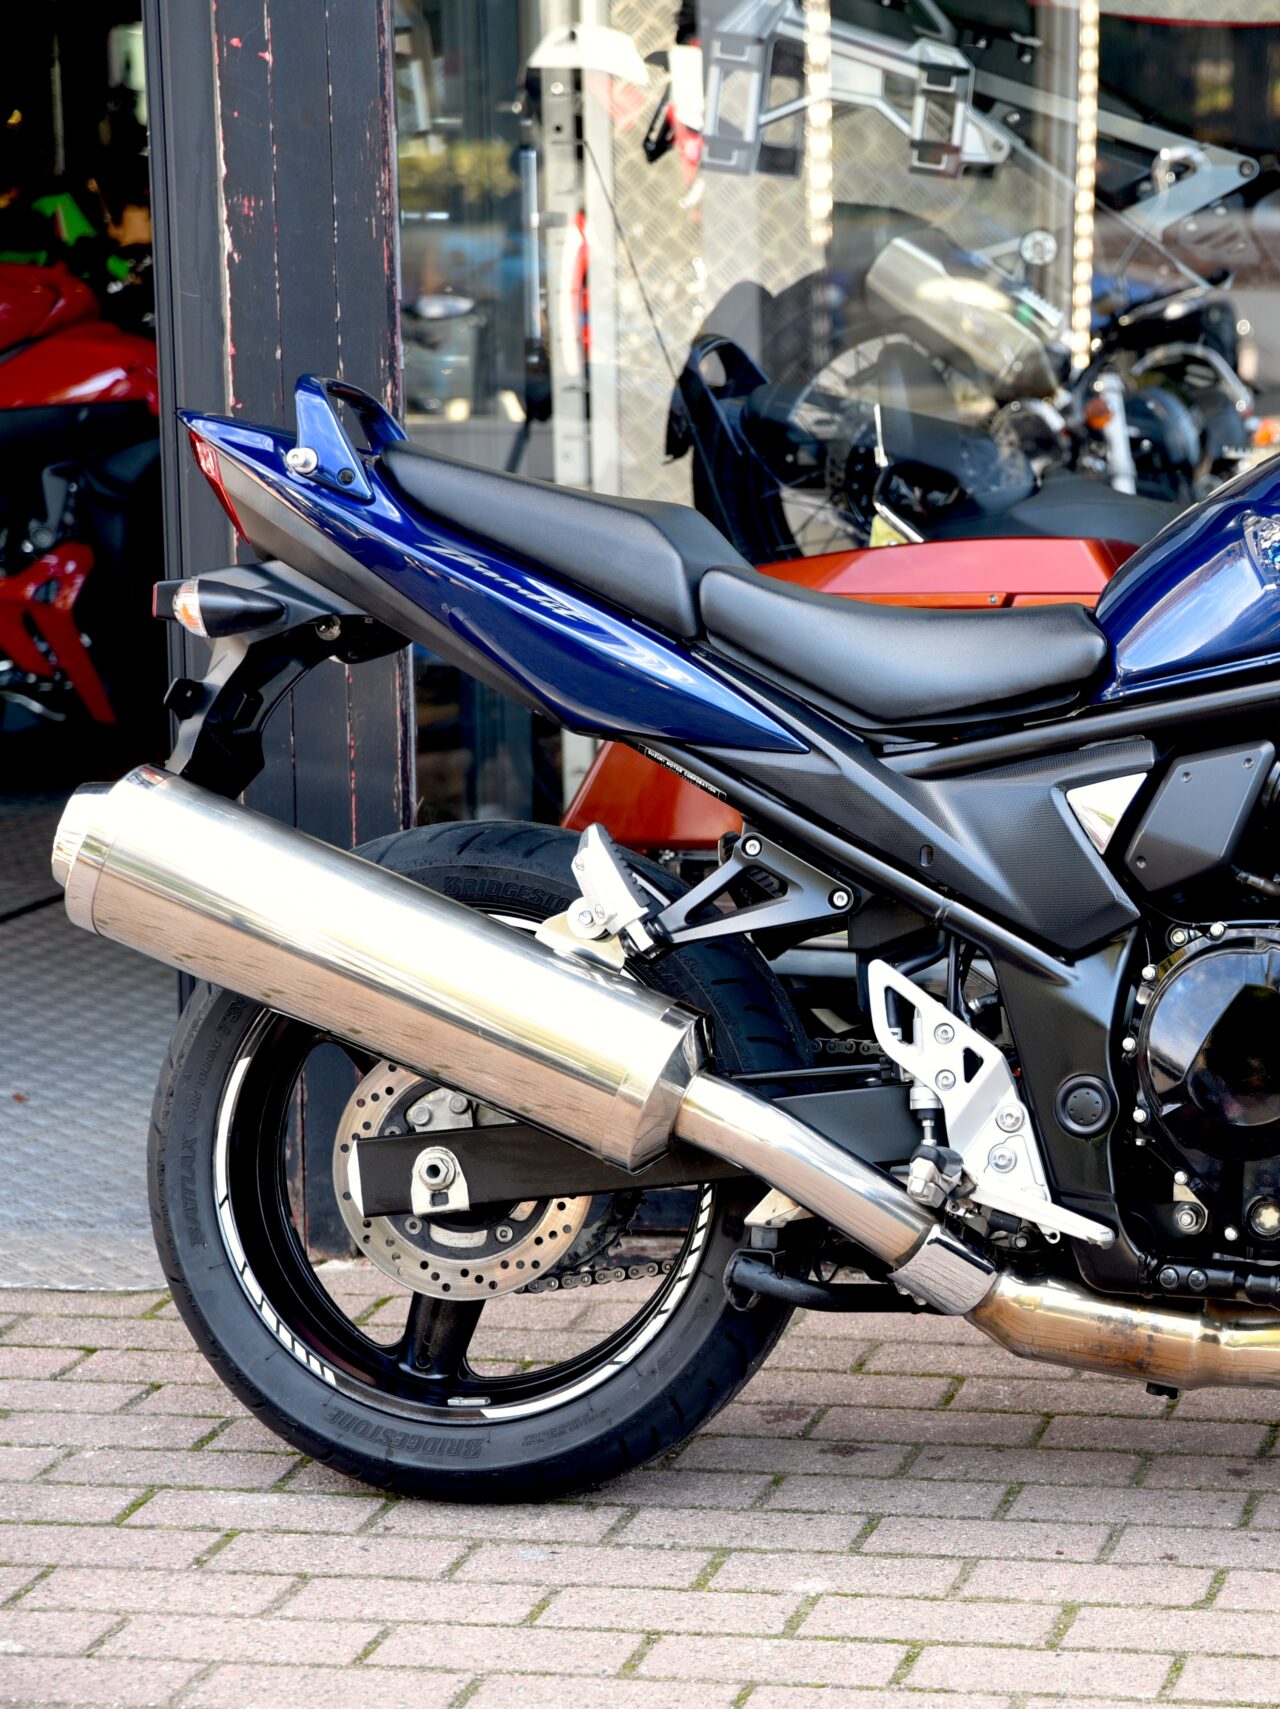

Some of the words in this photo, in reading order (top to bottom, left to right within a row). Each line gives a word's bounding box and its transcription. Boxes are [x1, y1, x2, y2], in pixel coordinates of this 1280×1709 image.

[415, 540, 593, 622] Bandit
[647, 747, 666, 764] SUZUKI
[666, 760, 683, 773] MOTOR
[683, 771, 717, 794] CORPORATION
[443, 876, 571, 911] BRIDGESTO
[179, 1133, 209, 1248] BATTLAX
[322, 1406, 486, 1458] BRIDGESTONE
